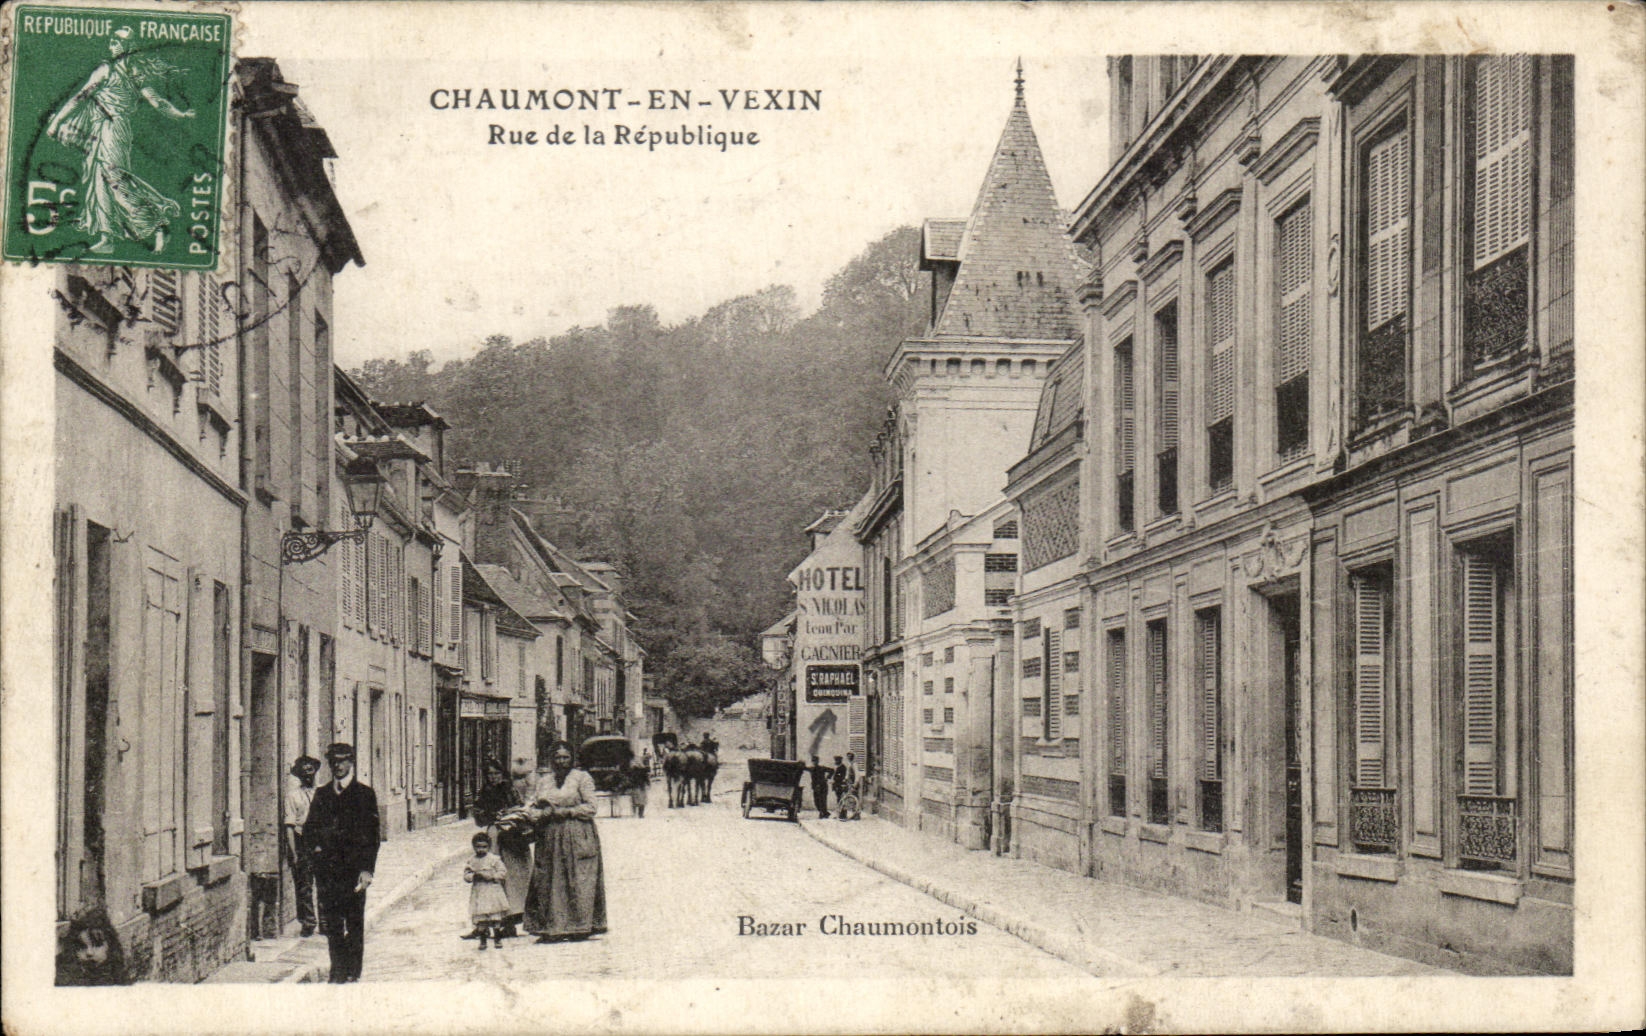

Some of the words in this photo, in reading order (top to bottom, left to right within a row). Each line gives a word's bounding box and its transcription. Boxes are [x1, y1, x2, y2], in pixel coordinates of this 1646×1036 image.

[140, 21, 221, 43] FRANÇAISE
[189, 171, 213, 255] POSTES
[798, 566, 865, 591] HOTEL
